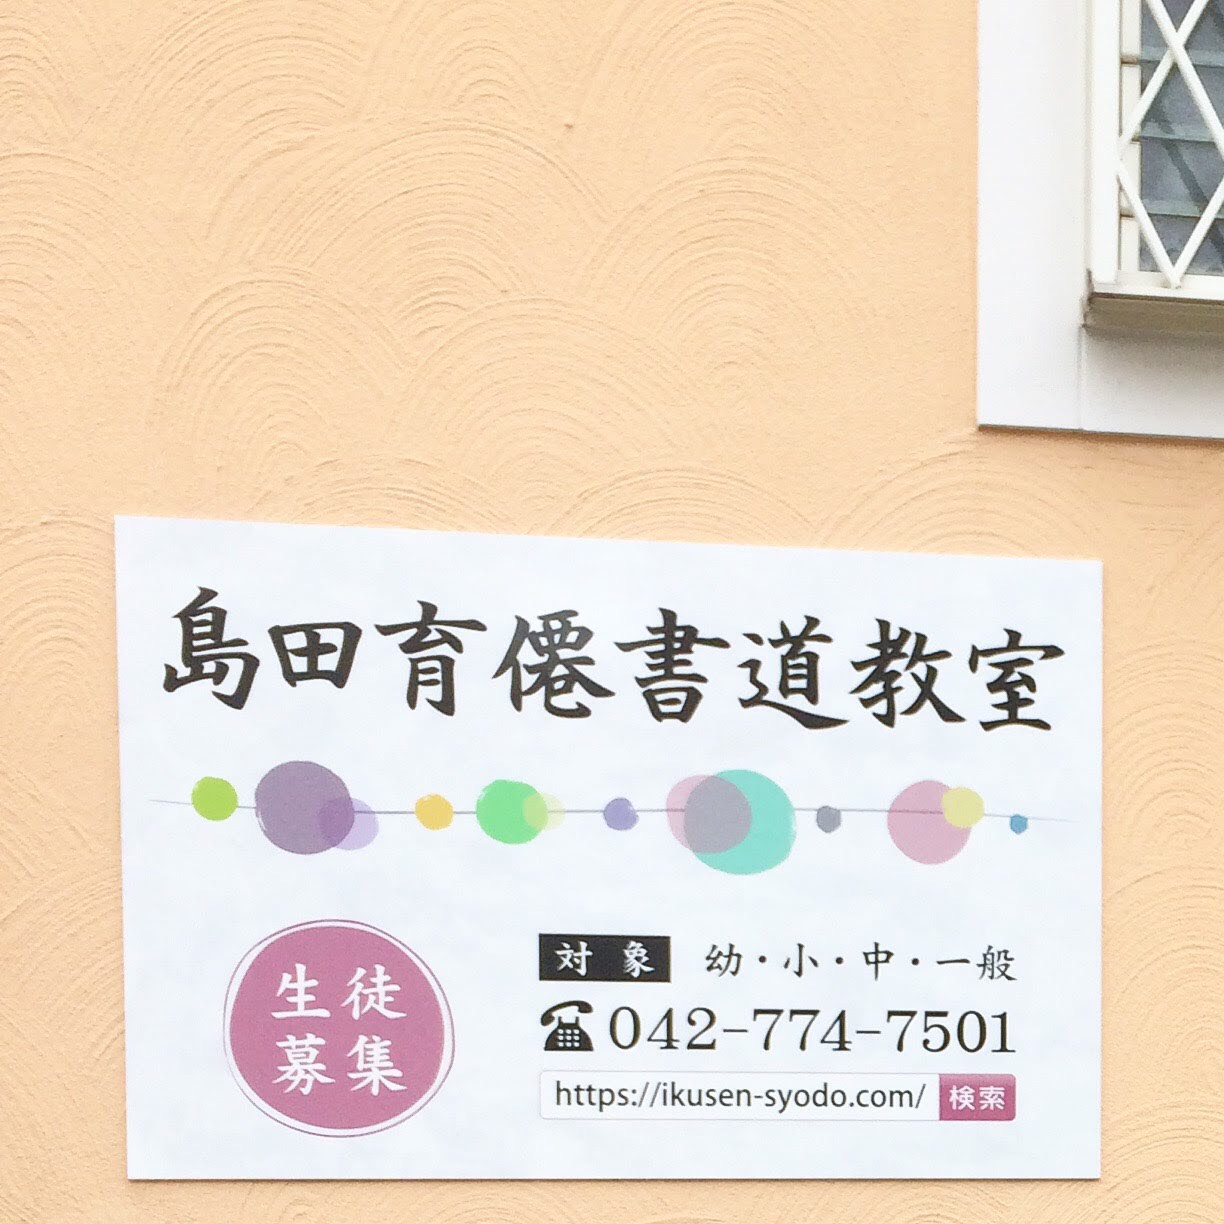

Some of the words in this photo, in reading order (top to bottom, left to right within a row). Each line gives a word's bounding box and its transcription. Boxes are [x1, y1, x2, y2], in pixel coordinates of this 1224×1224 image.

[555, 940, 655, 979] 対象
[270, 962, 408, 1021] 生徒
[609, 1006, 1016, 1053] 042-774-7501
[271, 1032, 408, 1096] 募集
[555, 1080, 926, 1113] https://ikusen-syodo.com/
[948, 1084, 1006, 1110] 検索
